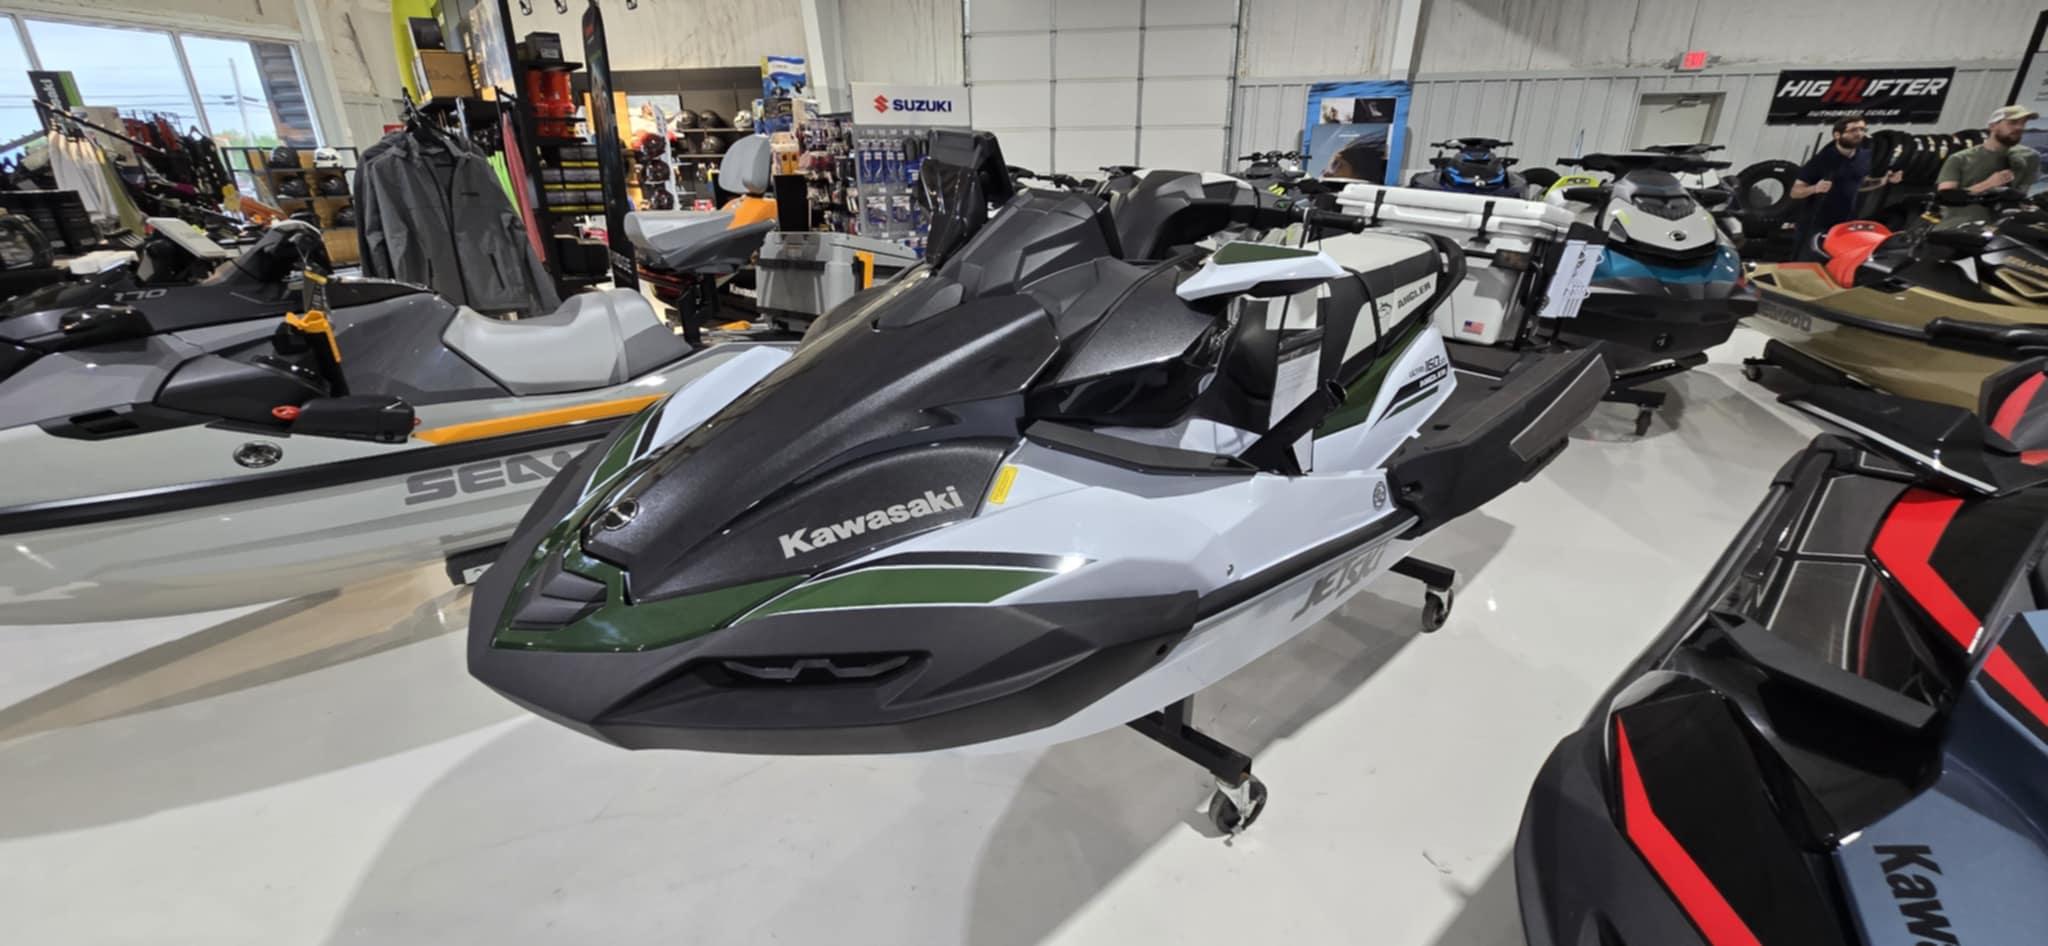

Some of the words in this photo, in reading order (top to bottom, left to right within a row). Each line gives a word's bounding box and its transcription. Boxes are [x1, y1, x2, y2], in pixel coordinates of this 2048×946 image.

[893, 99, 952, 112] SUZUKI
[114, 289, 167, 301] 170
[1398, 281, 1431, 309] ANGLER
[779, 486, 964, 558] Kawasaki
[1873, 845, 1961, 946] Kaw
